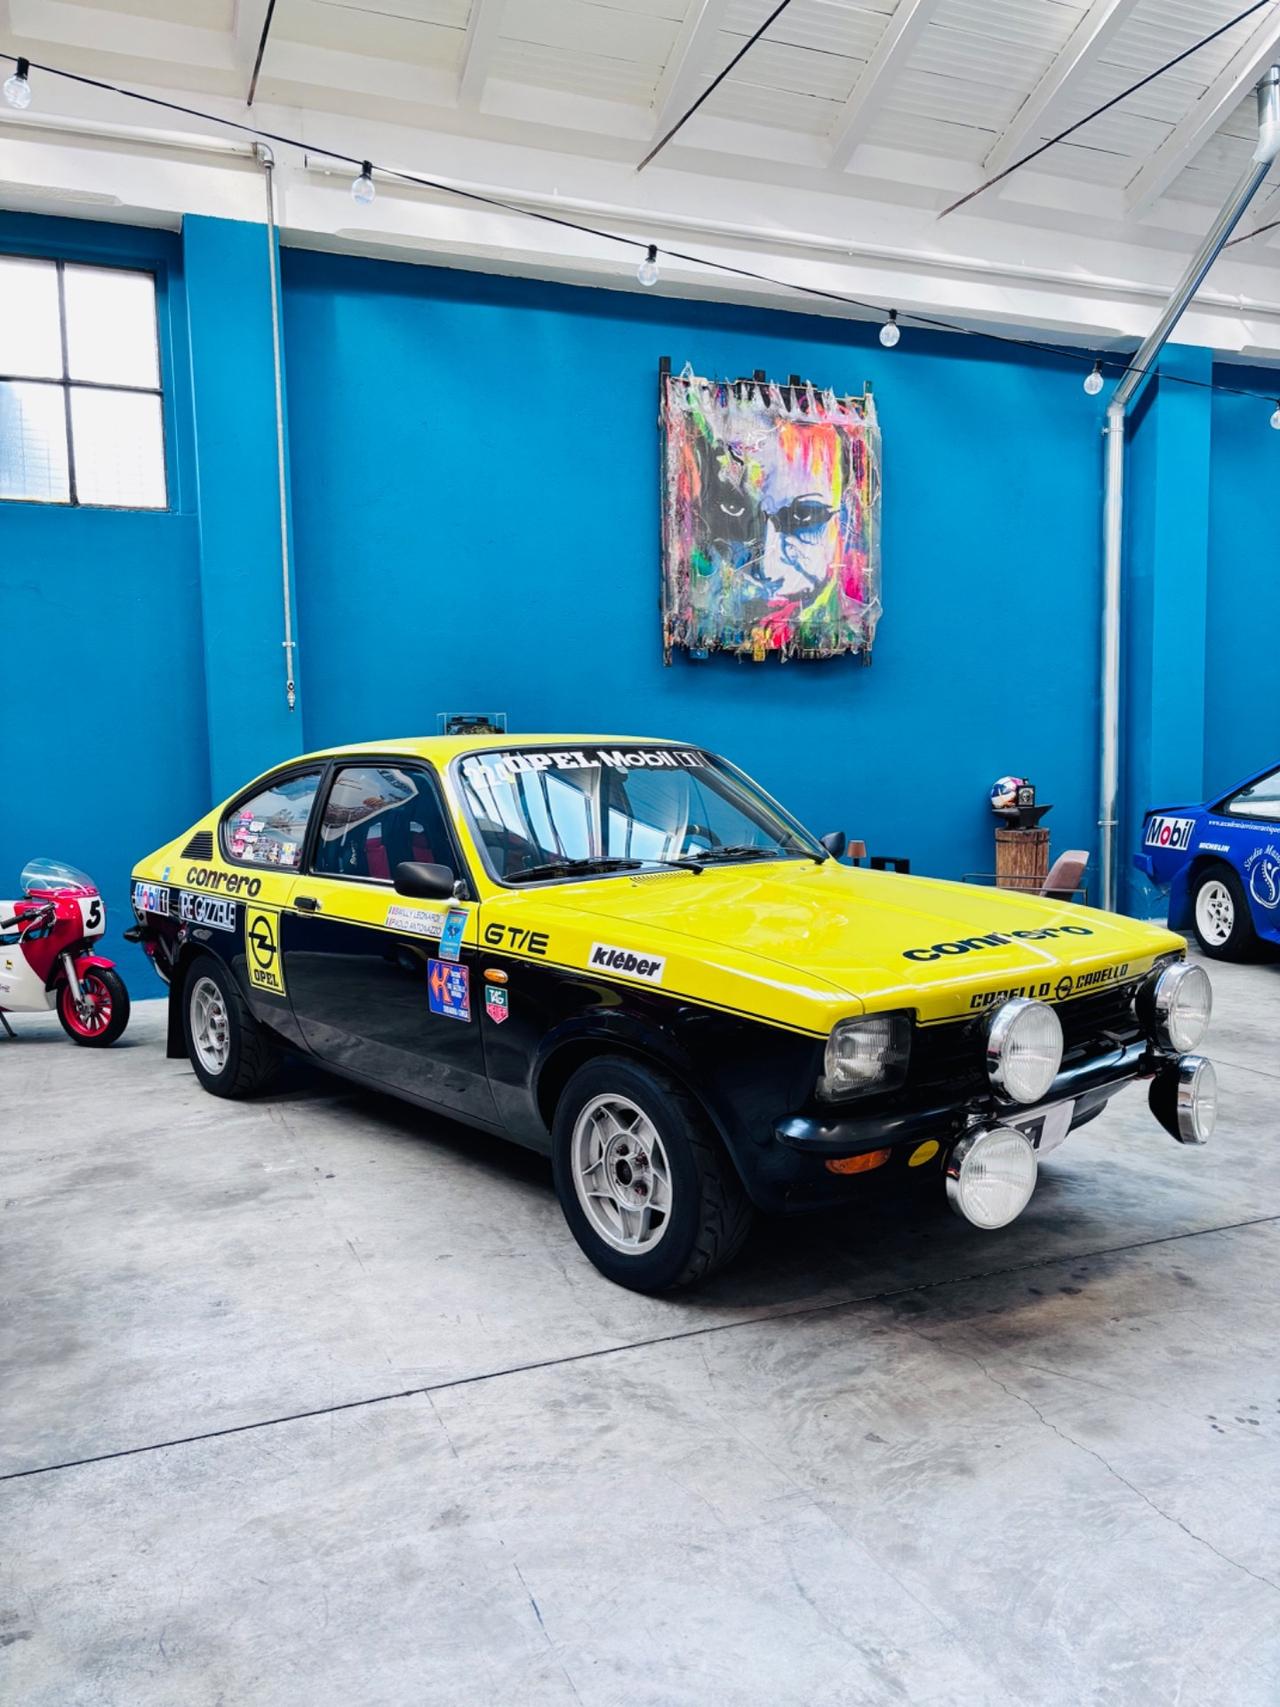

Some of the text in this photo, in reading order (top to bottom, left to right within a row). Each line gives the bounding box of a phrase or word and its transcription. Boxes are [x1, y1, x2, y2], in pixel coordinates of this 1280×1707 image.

[501, 751, 602, 774] OPEL
[596, 750, 679, 767] Mobil
[1147, 817, 1192, 849] Mobil
[186, 867, 262, 897] conrero
[86, 900, 101, 929] 5
[484, 923, 549, 955] GT/E
[902, 925, 1094, 962] conrero
[254, 969, 279, 988] OPEL
[1075, 963, 1129, 989] CARELLO
[488, 989, 505, 1005] TAG
